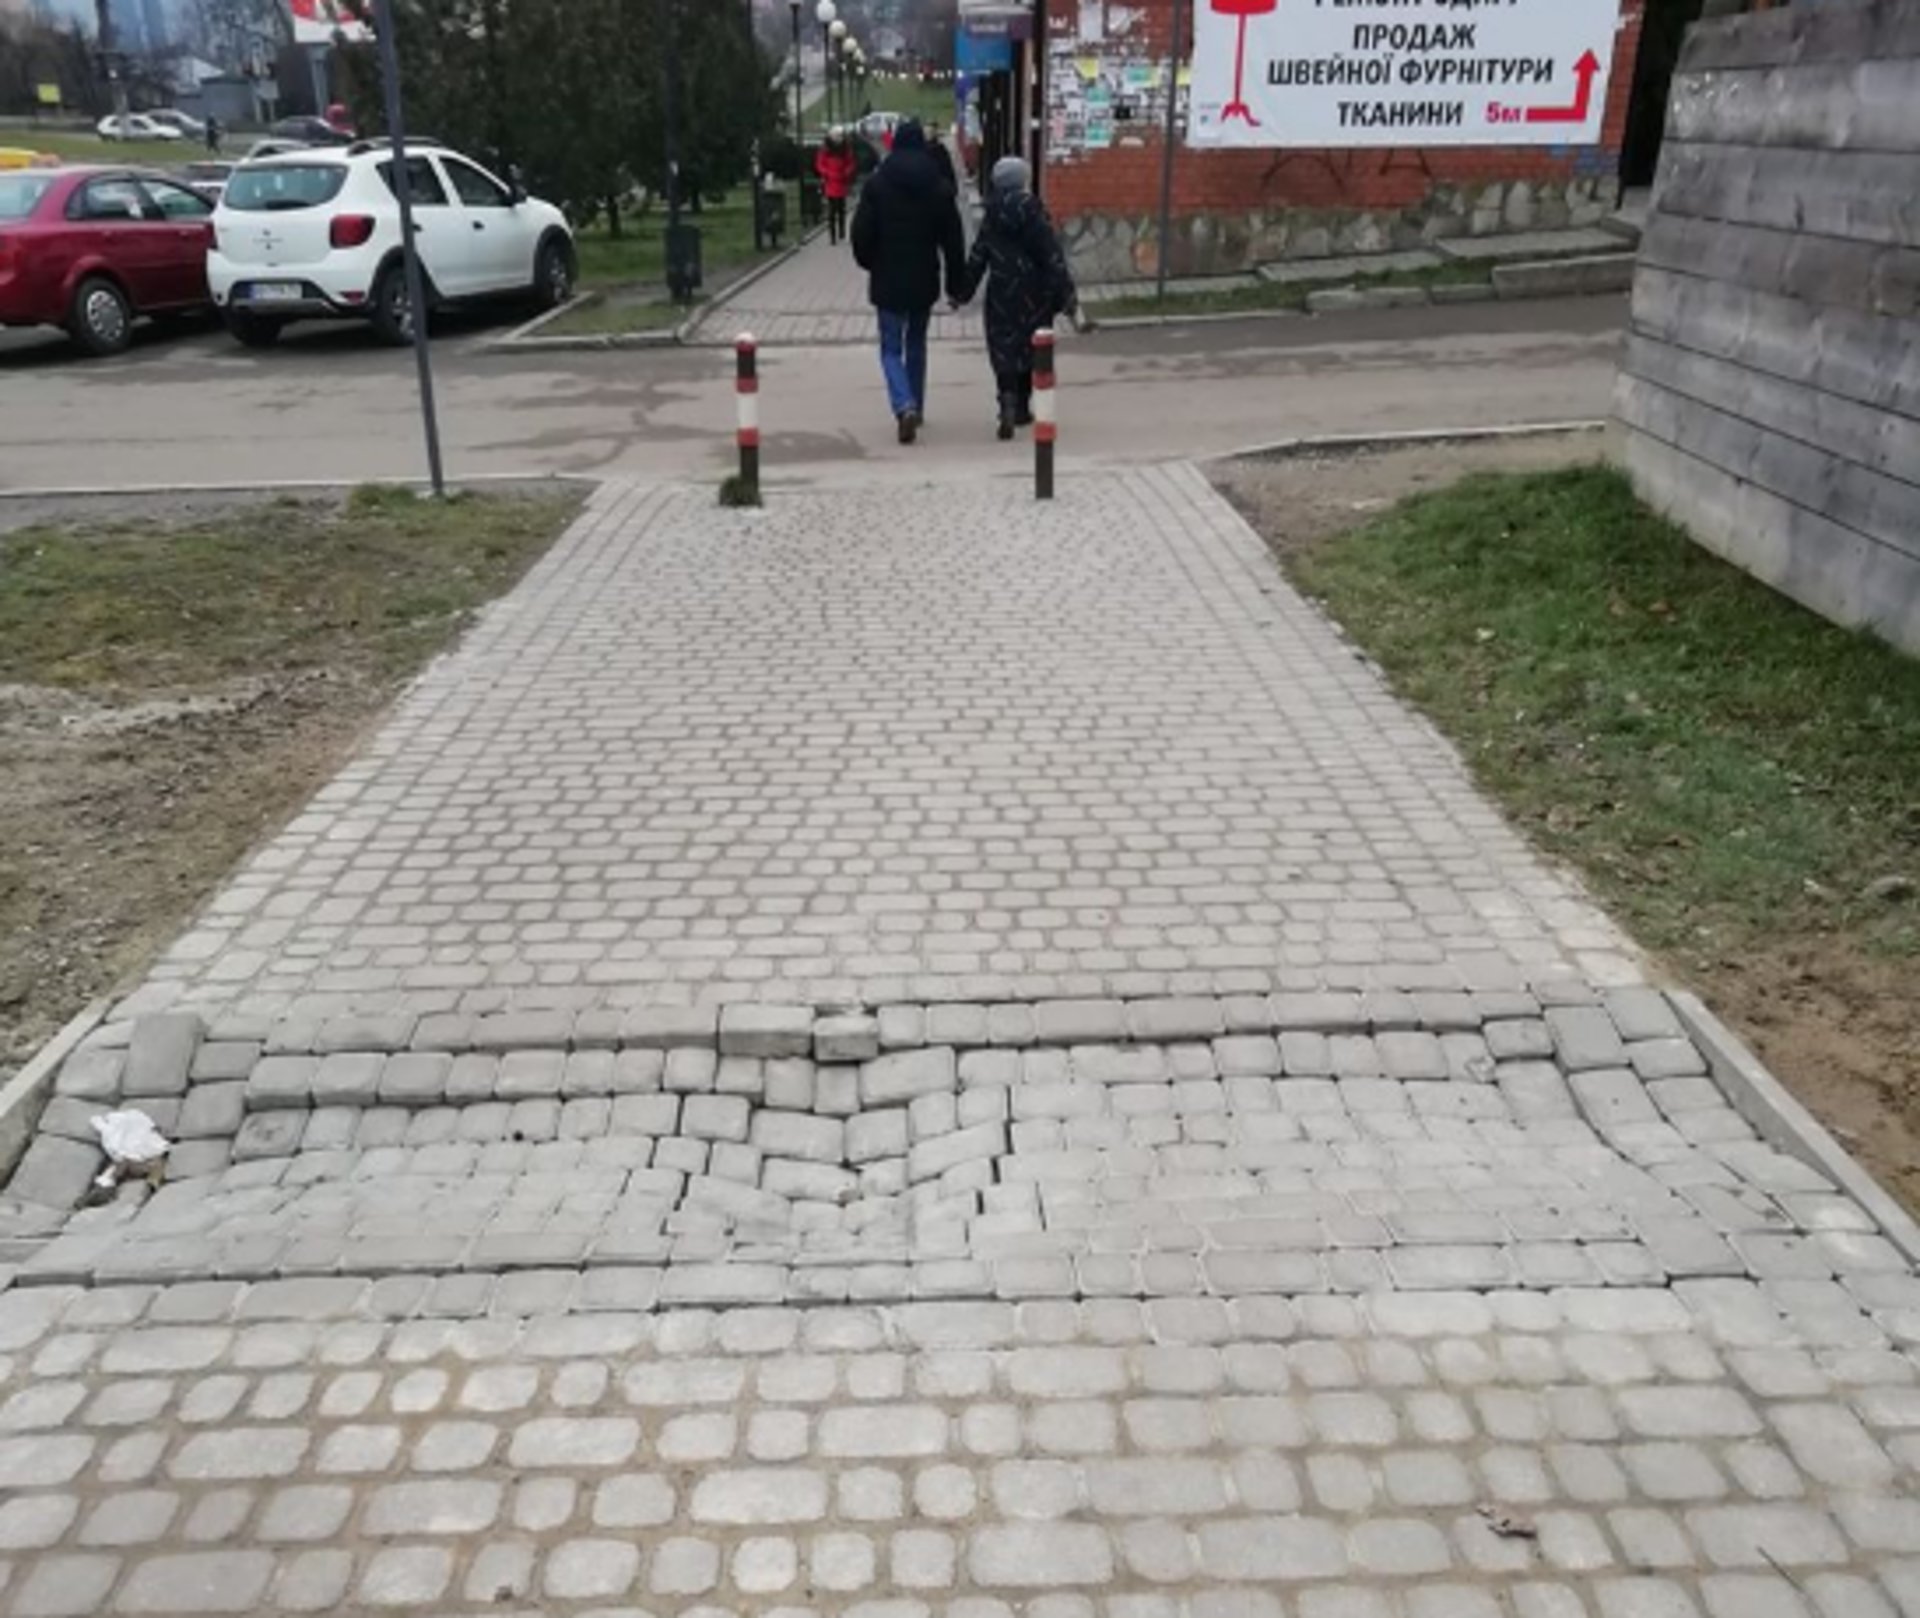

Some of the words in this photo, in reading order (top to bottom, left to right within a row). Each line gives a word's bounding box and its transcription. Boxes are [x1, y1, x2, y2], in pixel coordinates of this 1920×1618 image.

[1353, 23, 1477, 53] ПРОДАЖ
[1267, 52, 1395, 86] ШВЕЙНОЇ
[1399, 58, 1554, 85] ФУРНІТУРИ
[1338, 100, 1463, 127] ТКАНИНИ
